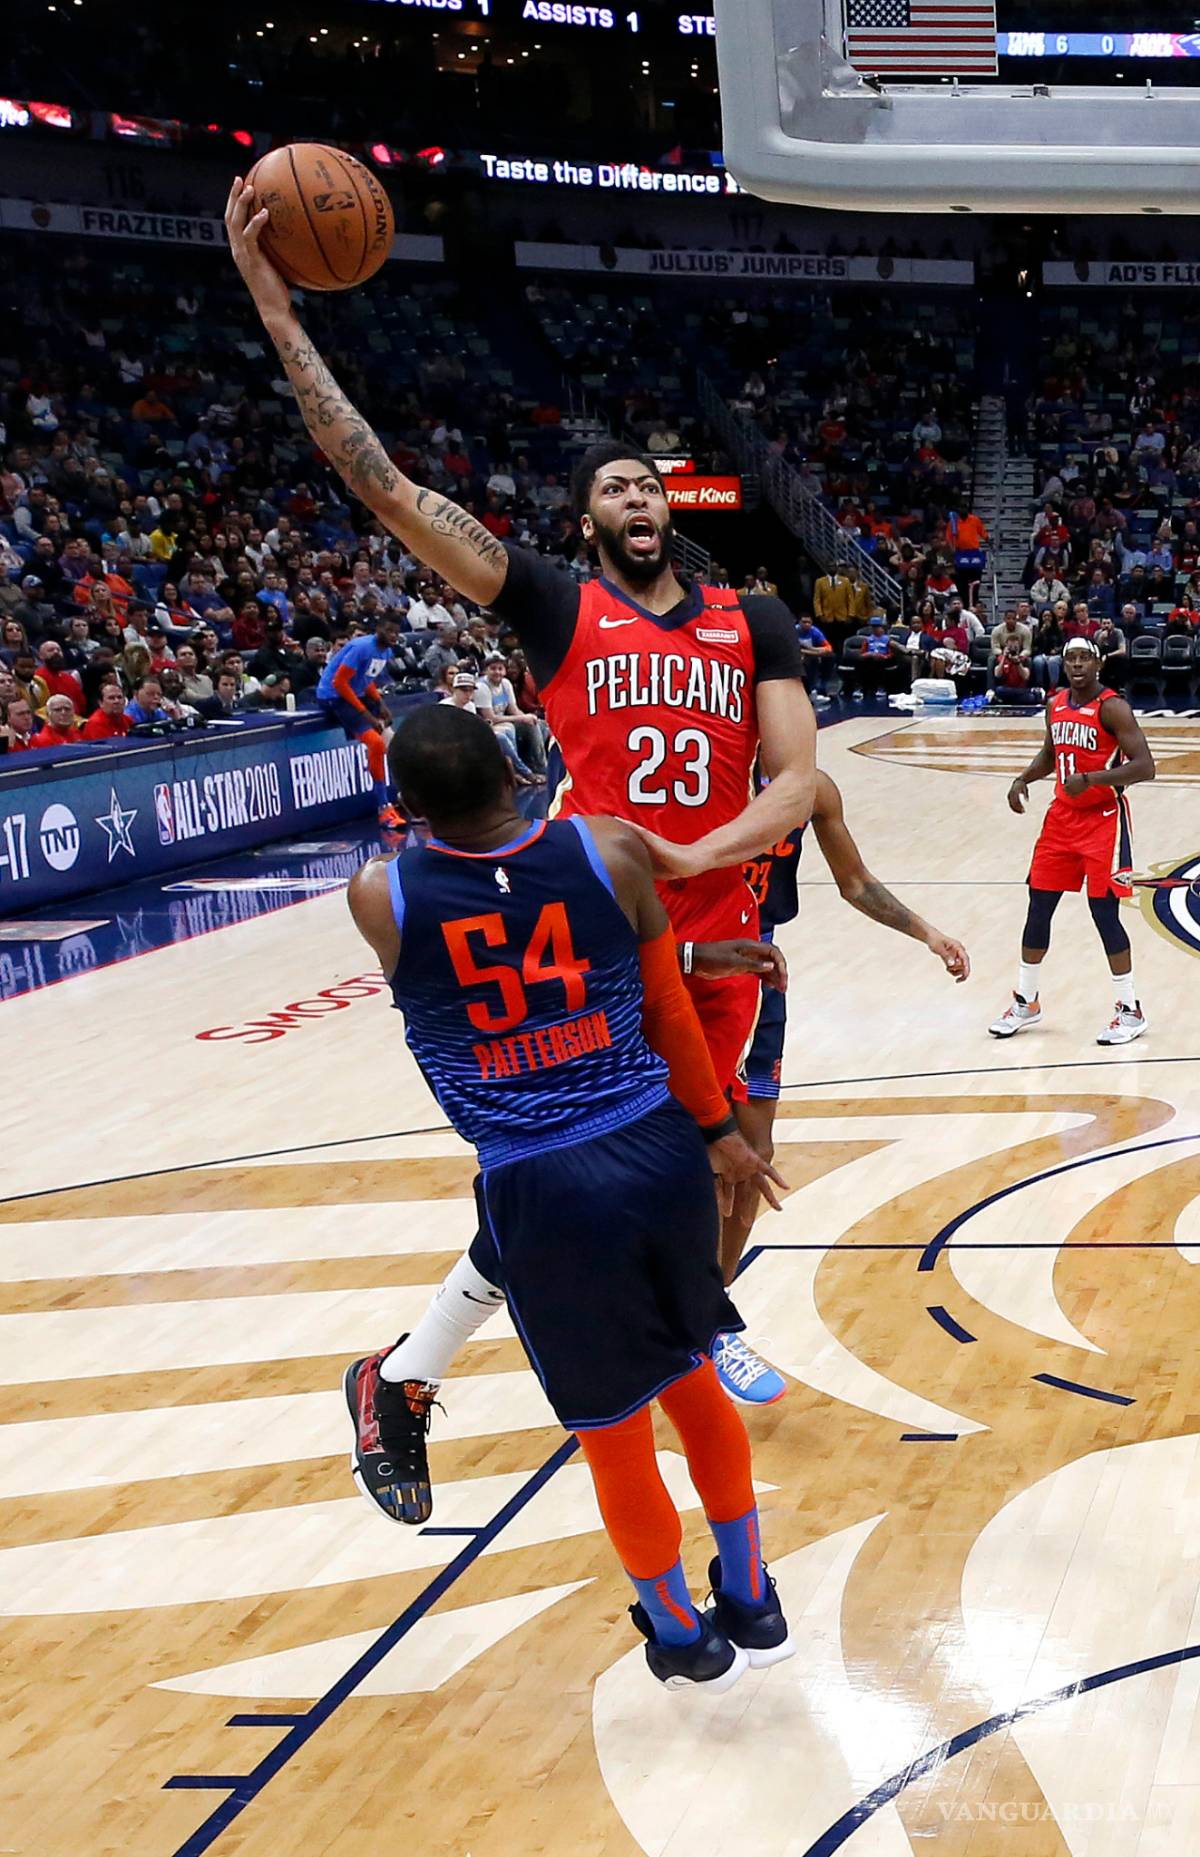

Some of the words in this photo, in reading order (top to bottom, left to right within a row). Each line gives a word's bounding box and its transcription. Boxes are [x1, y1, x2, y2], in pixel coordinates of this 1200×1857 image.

[522, 1, 613, 28] ASSISTS
[627, 12, 638, 32] 1
[1057, 36, 1068, 53] 6
[1102, 36, 1113, 53] 0
[480, 154, 548, 181] Taste
[553, 161, 593, 186] the
[598, 163, 720, 193] Difference
[83, 211, 214, 240] FRAZIER'S
[651, 253, 734, 273] JULIUS'
[740, 256, 846, 276] JUMPERS
[1109, 265, 1156, 282] AD'S
[586, 652, 746, 724] PELICANS
[1051, 721, 1097, 751] ELICANS
[290, 745, 357, 810] FEBRUARY
[627, 725, 711, 807] 23
[1058, 752, 1075, 785] 11
[440, 901, 591, 1033] 54
[473, 1009, 613, 1081] PATTERSON
